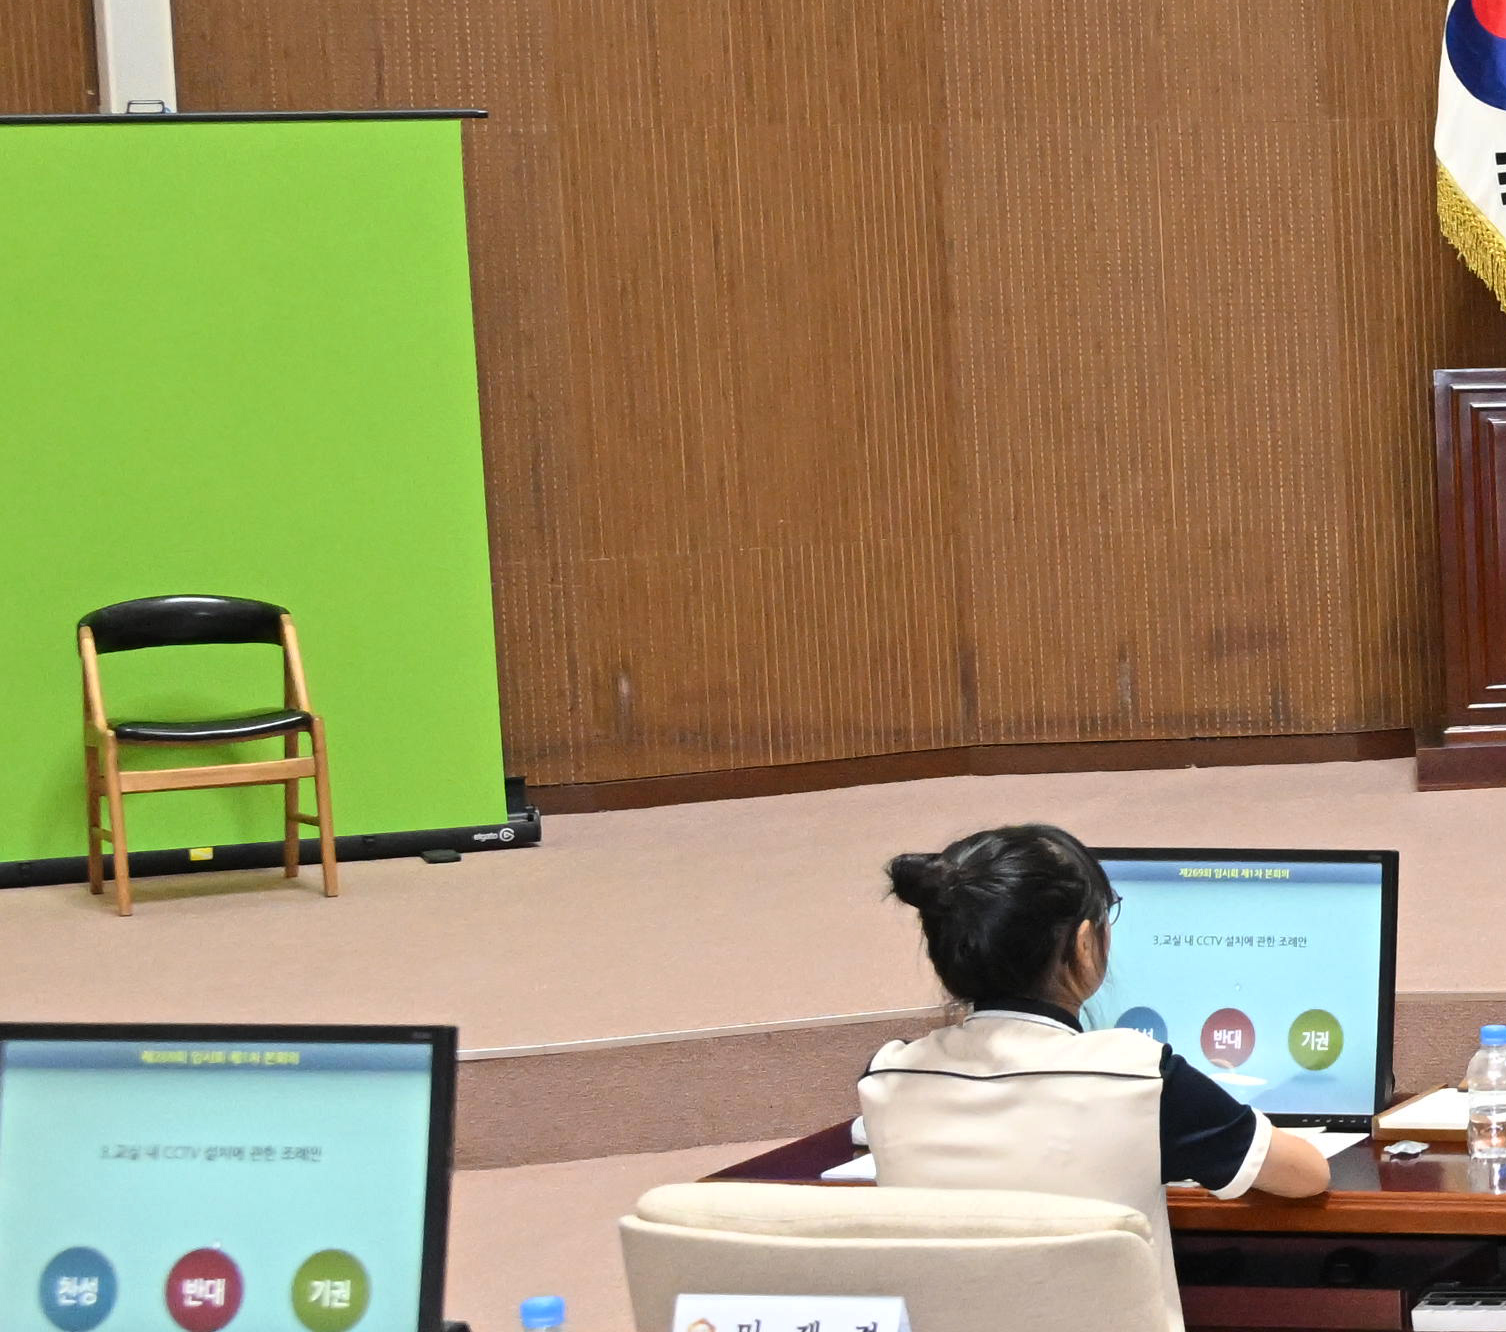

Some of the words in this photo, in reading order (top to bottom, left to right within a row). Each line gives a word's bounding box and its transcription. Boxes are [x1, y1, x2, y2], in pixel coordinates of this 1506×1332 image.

[1184, 934, 1194, 946] 내
[1197, 935, 1222, 946] CCTV
[1213, 1028, 1242, 1050] 반대
[1300, 1029, 1330, 1052] 기권
[56, 1275, 99, 1307] 찬성
[181, 1278, 226, 1308] 반대
[308, 1279, 352, 1309] 기권
